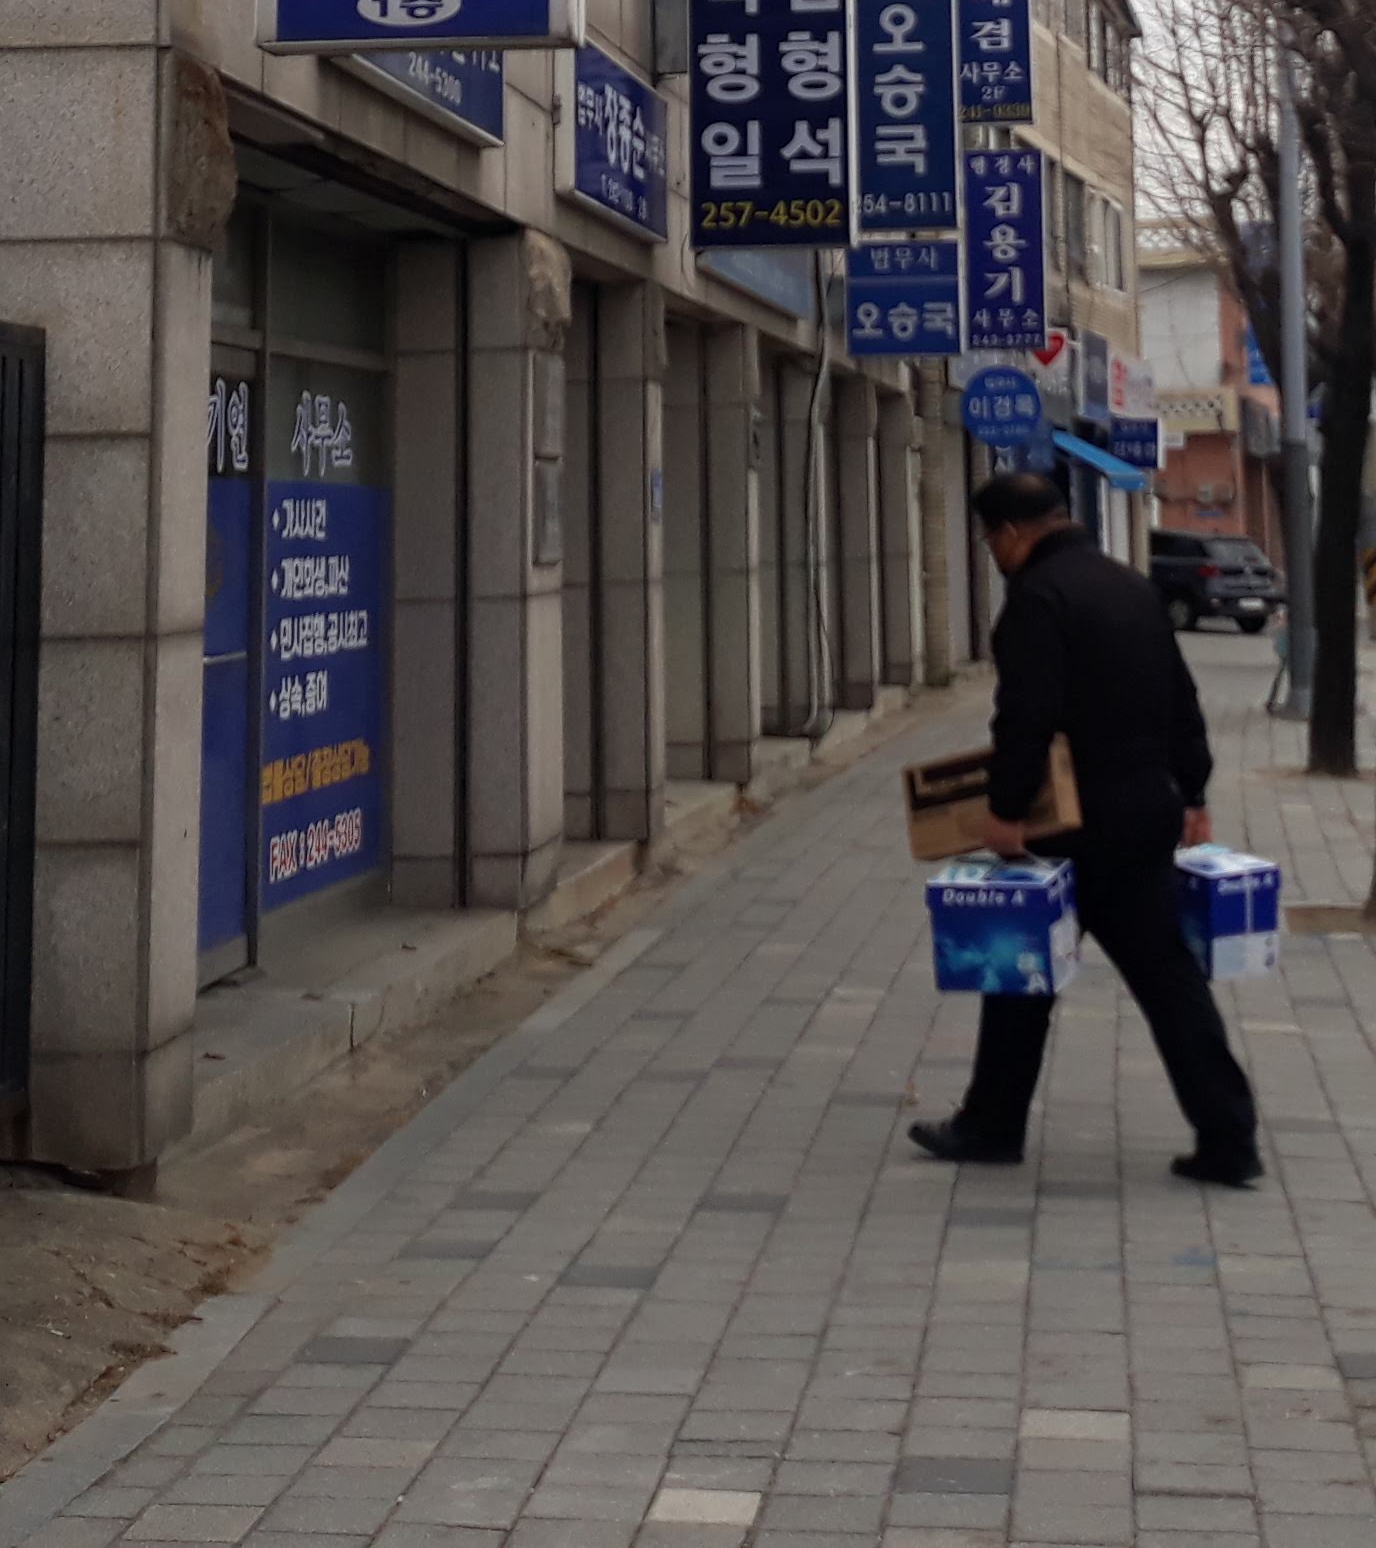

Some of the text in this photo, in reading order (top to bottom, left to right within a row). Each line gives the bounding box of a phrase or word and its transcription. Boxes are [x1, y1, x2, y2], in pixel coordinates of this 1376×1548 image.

[873, 2, 928, 177] 오승국
[960, 60, 1024, 84] 사무소
[699, 200, 841, 229] 257-4502
[982, 182, 1028, 305] 김용기
[852, 302, 956, 340] 오승국
[290, 390, 353, 477] 사무소
[943, 888, 1006, 907] Double
